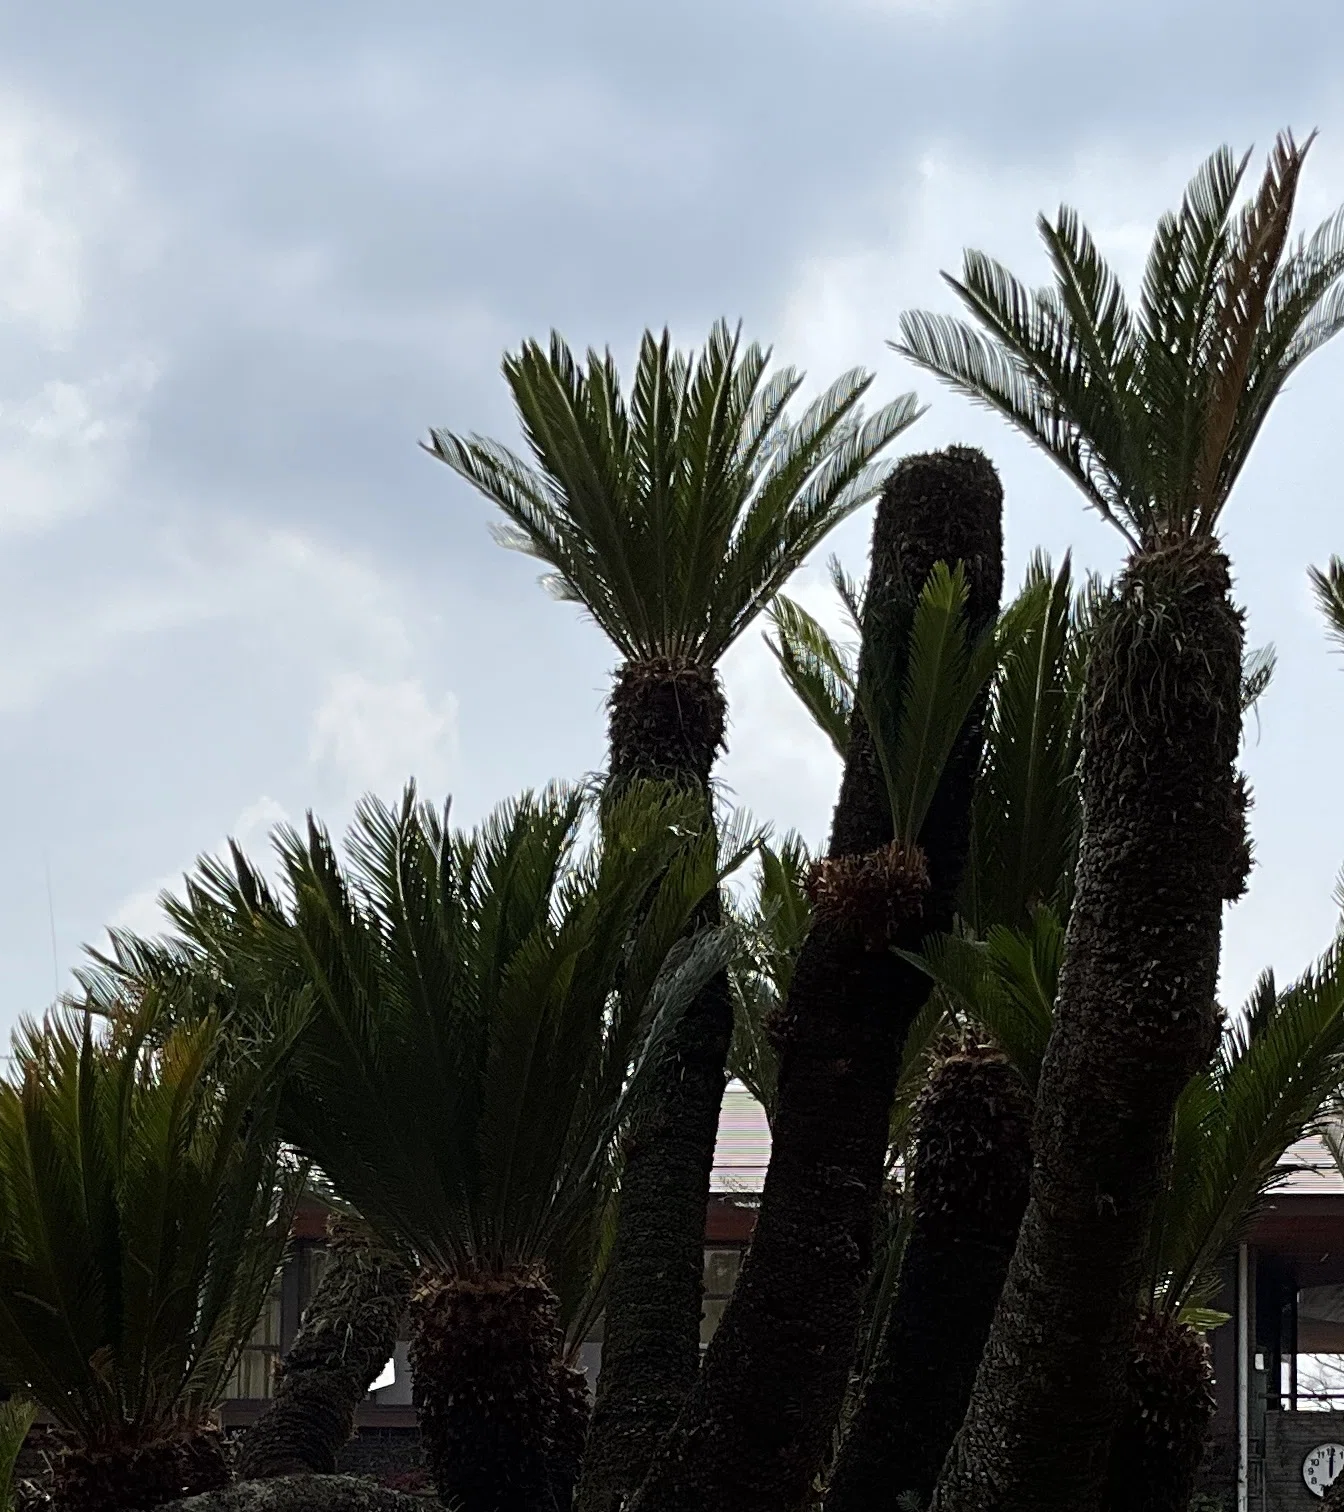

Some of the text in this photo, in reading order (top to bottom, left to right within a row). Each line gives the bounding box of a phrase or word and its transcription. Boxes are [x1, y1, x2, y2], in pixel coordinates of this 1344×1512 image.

[1317, 1450, 1325, 1459] 11
[1339, 1450, 1344, 1460] 1
[1310, 1458, 1320, 1467] 10
[1307, 1467, 1314, 1476] 9
[1310, 1476, 1318, 1485] 8
